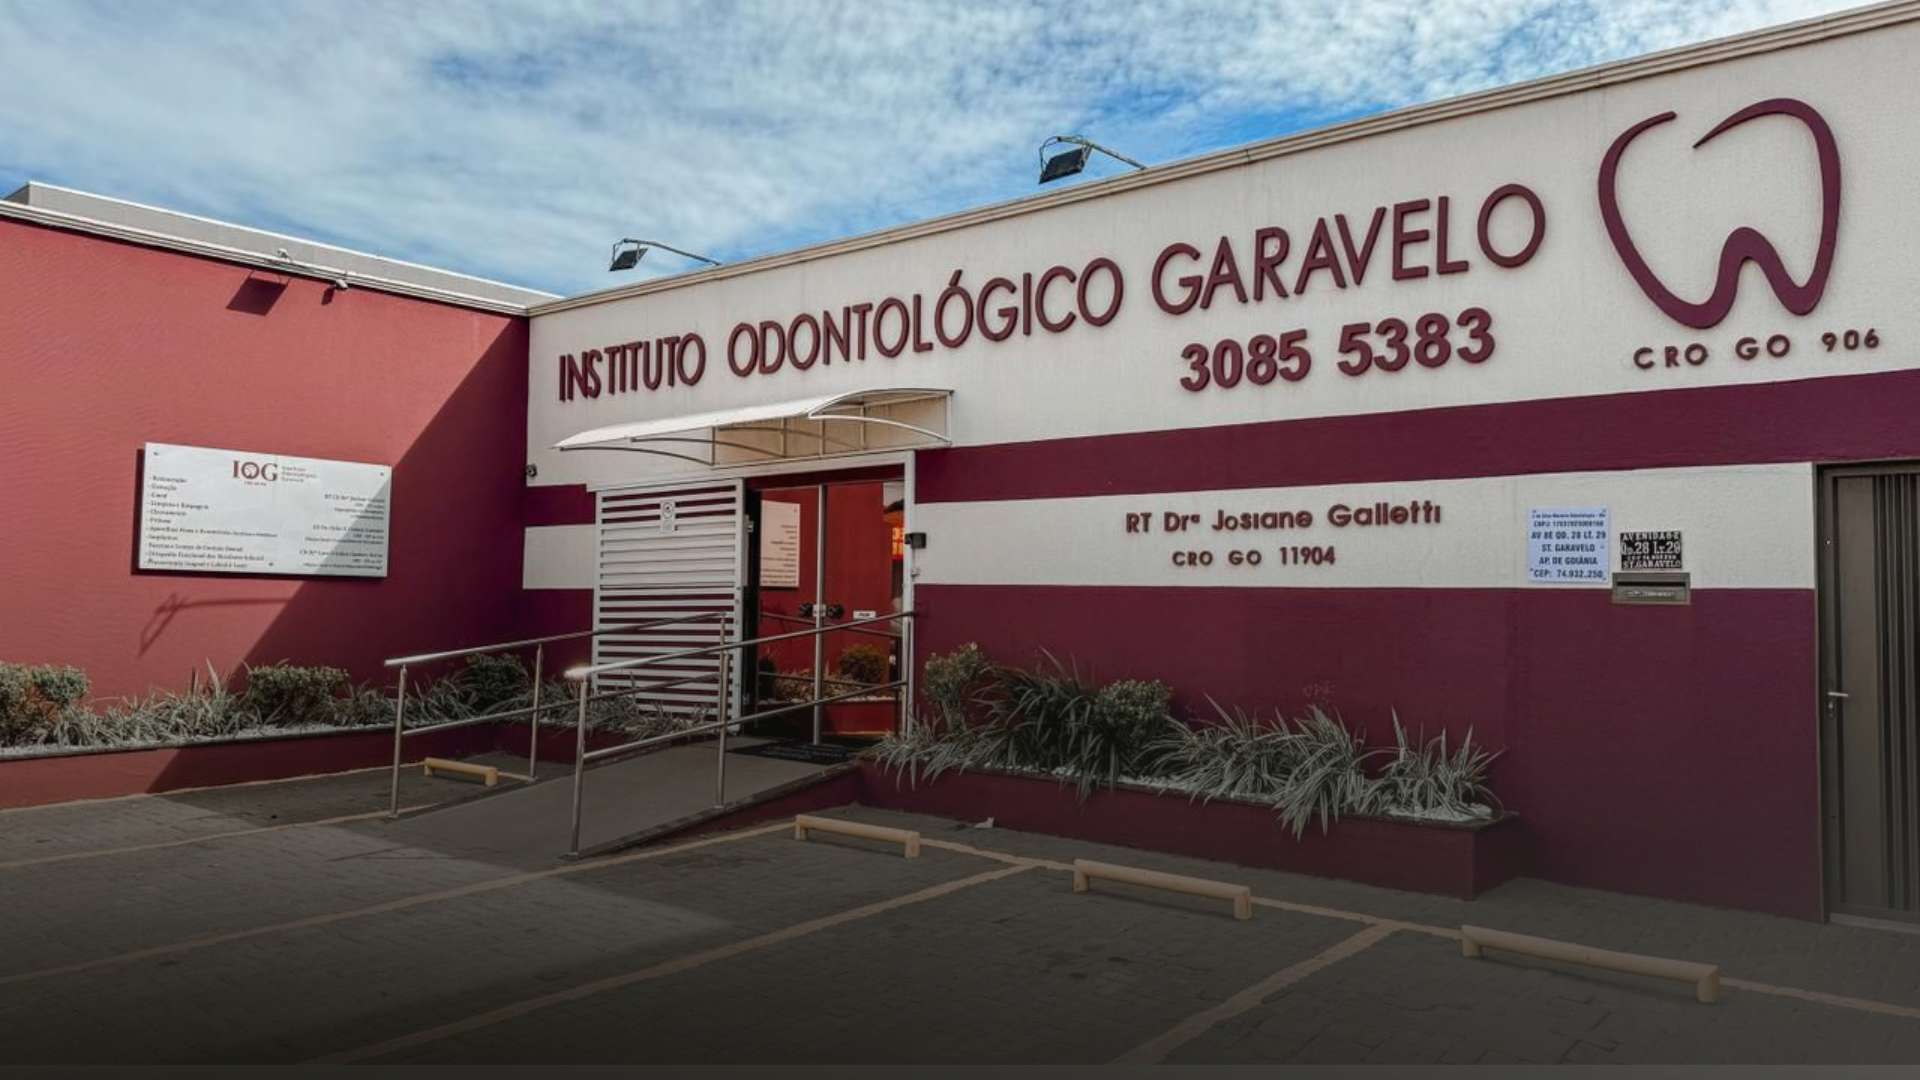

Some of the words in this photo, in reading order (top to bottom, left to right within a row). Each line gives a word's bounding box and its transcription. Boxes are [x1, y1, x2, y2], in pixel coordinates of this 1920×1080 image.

[558, 332, 707, 403] INSTITUTO
[727, 257, 1125, 379] ODONTOLÓGICO
[1151, 183, 1547, 316] GARAVELO
[1179, 328, 1312, 393] 3085
[1336, 307, 1496, 378] 5383
[1633, 343, 1709, 371] CRO
[1735, 334, 1791, 362] GO
[1821, 328, 1881, 353] 906
[1125, 512, 1153, 534] RT
[1211, 509, 1314, 532] Josiane
[1327, 500, 1441, 528] Galletti
[1531, 531, 1541, 539] AV
[1571, 531, 1581, 539] 28
[1595, 530, 1606, 539] 29
[1555, 543, 1596, 552] GARAVELO
[1171, 550, 1214, 567] CRO
[1227, 550, 1263, 567] GO
[1279, 546, 1336, 567] 11904
[1552, 557, 1563, 565] DE
[1564, 556, 1598, 565] GOIÂNIA
